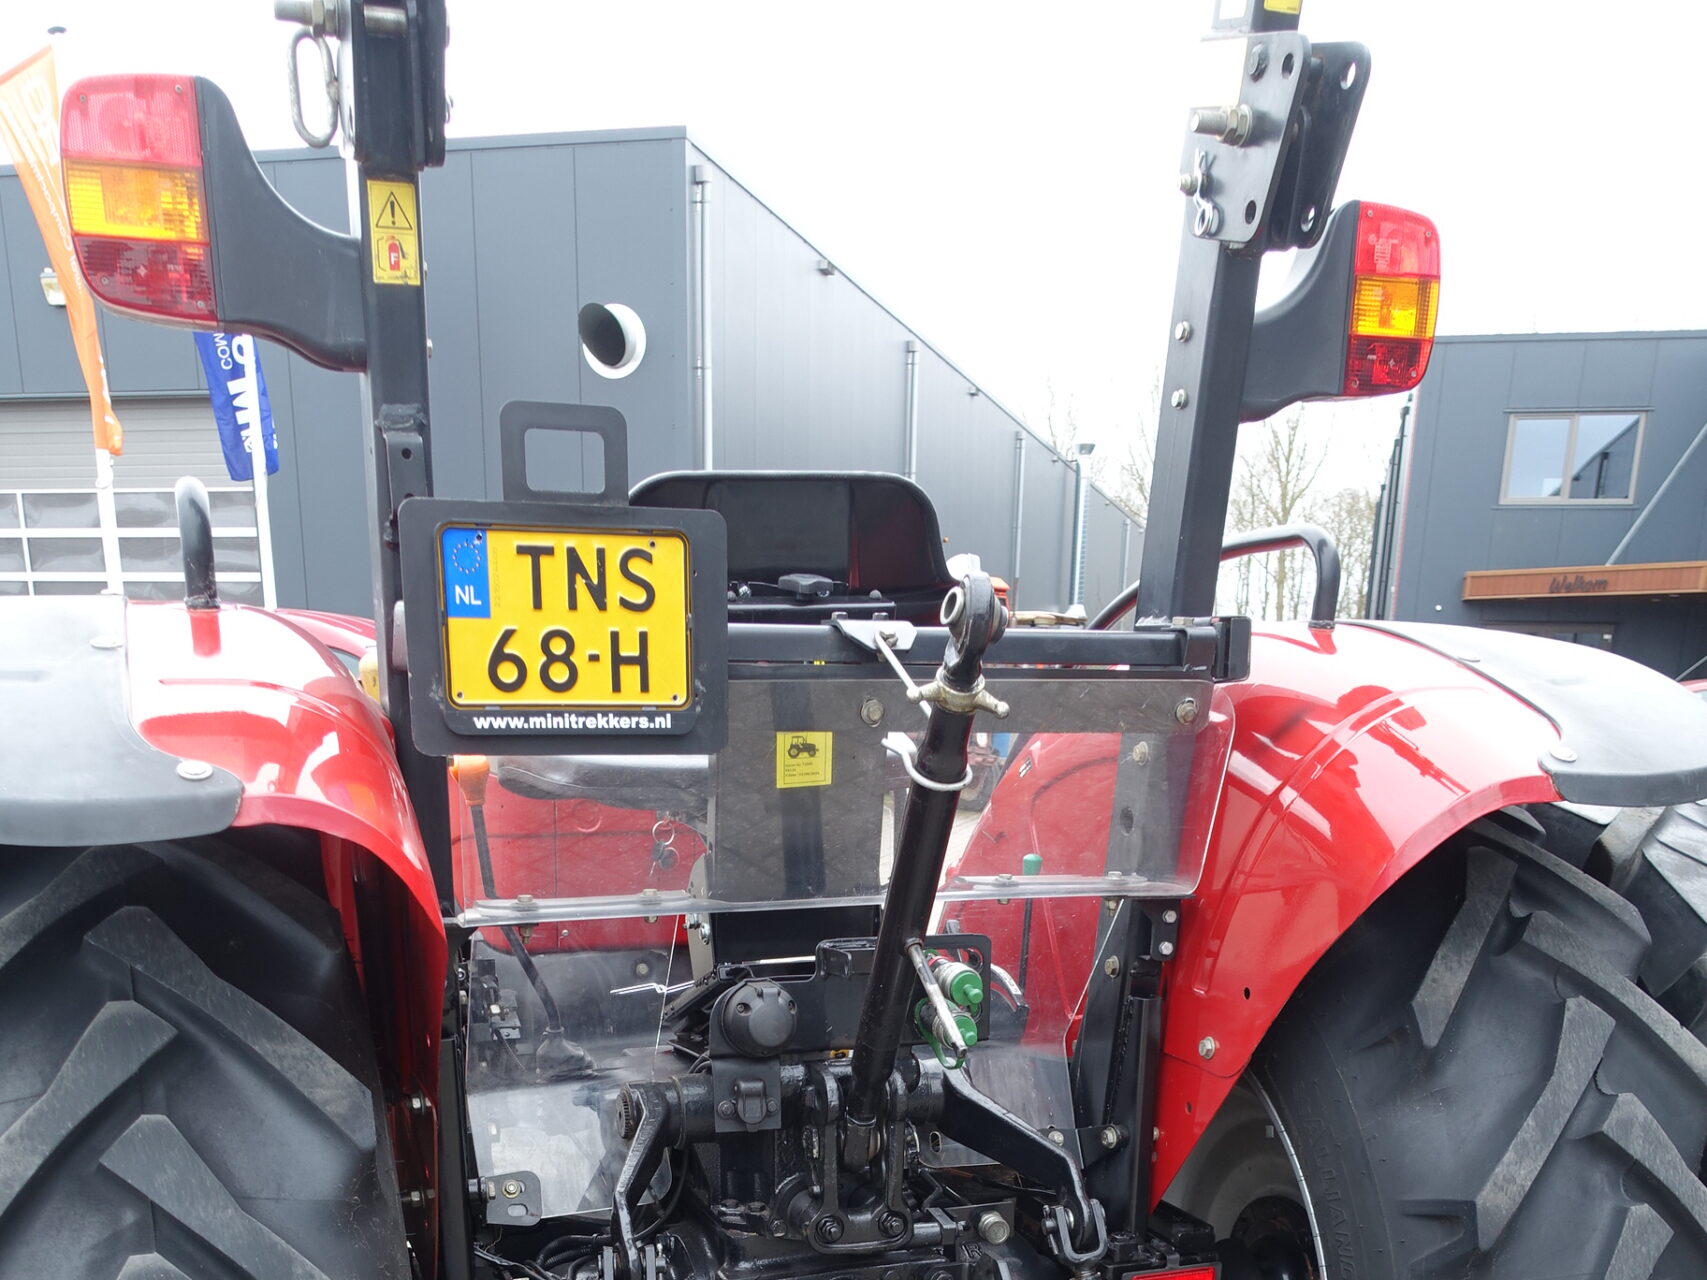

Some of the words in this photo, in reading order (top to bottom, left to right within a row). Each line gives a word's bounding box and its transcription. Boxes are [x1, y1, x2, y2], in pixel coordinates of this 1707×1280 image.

[390, 253, 399, 265] F
[516, 545, 656, 612] TNS
[1549, 575, 1608, 593] Welkom
[455, 584, 482, 605] NL
[487, 628, 650, 694] 68-H
[473, 713, 672, 729] www.minitrekkers.nl
